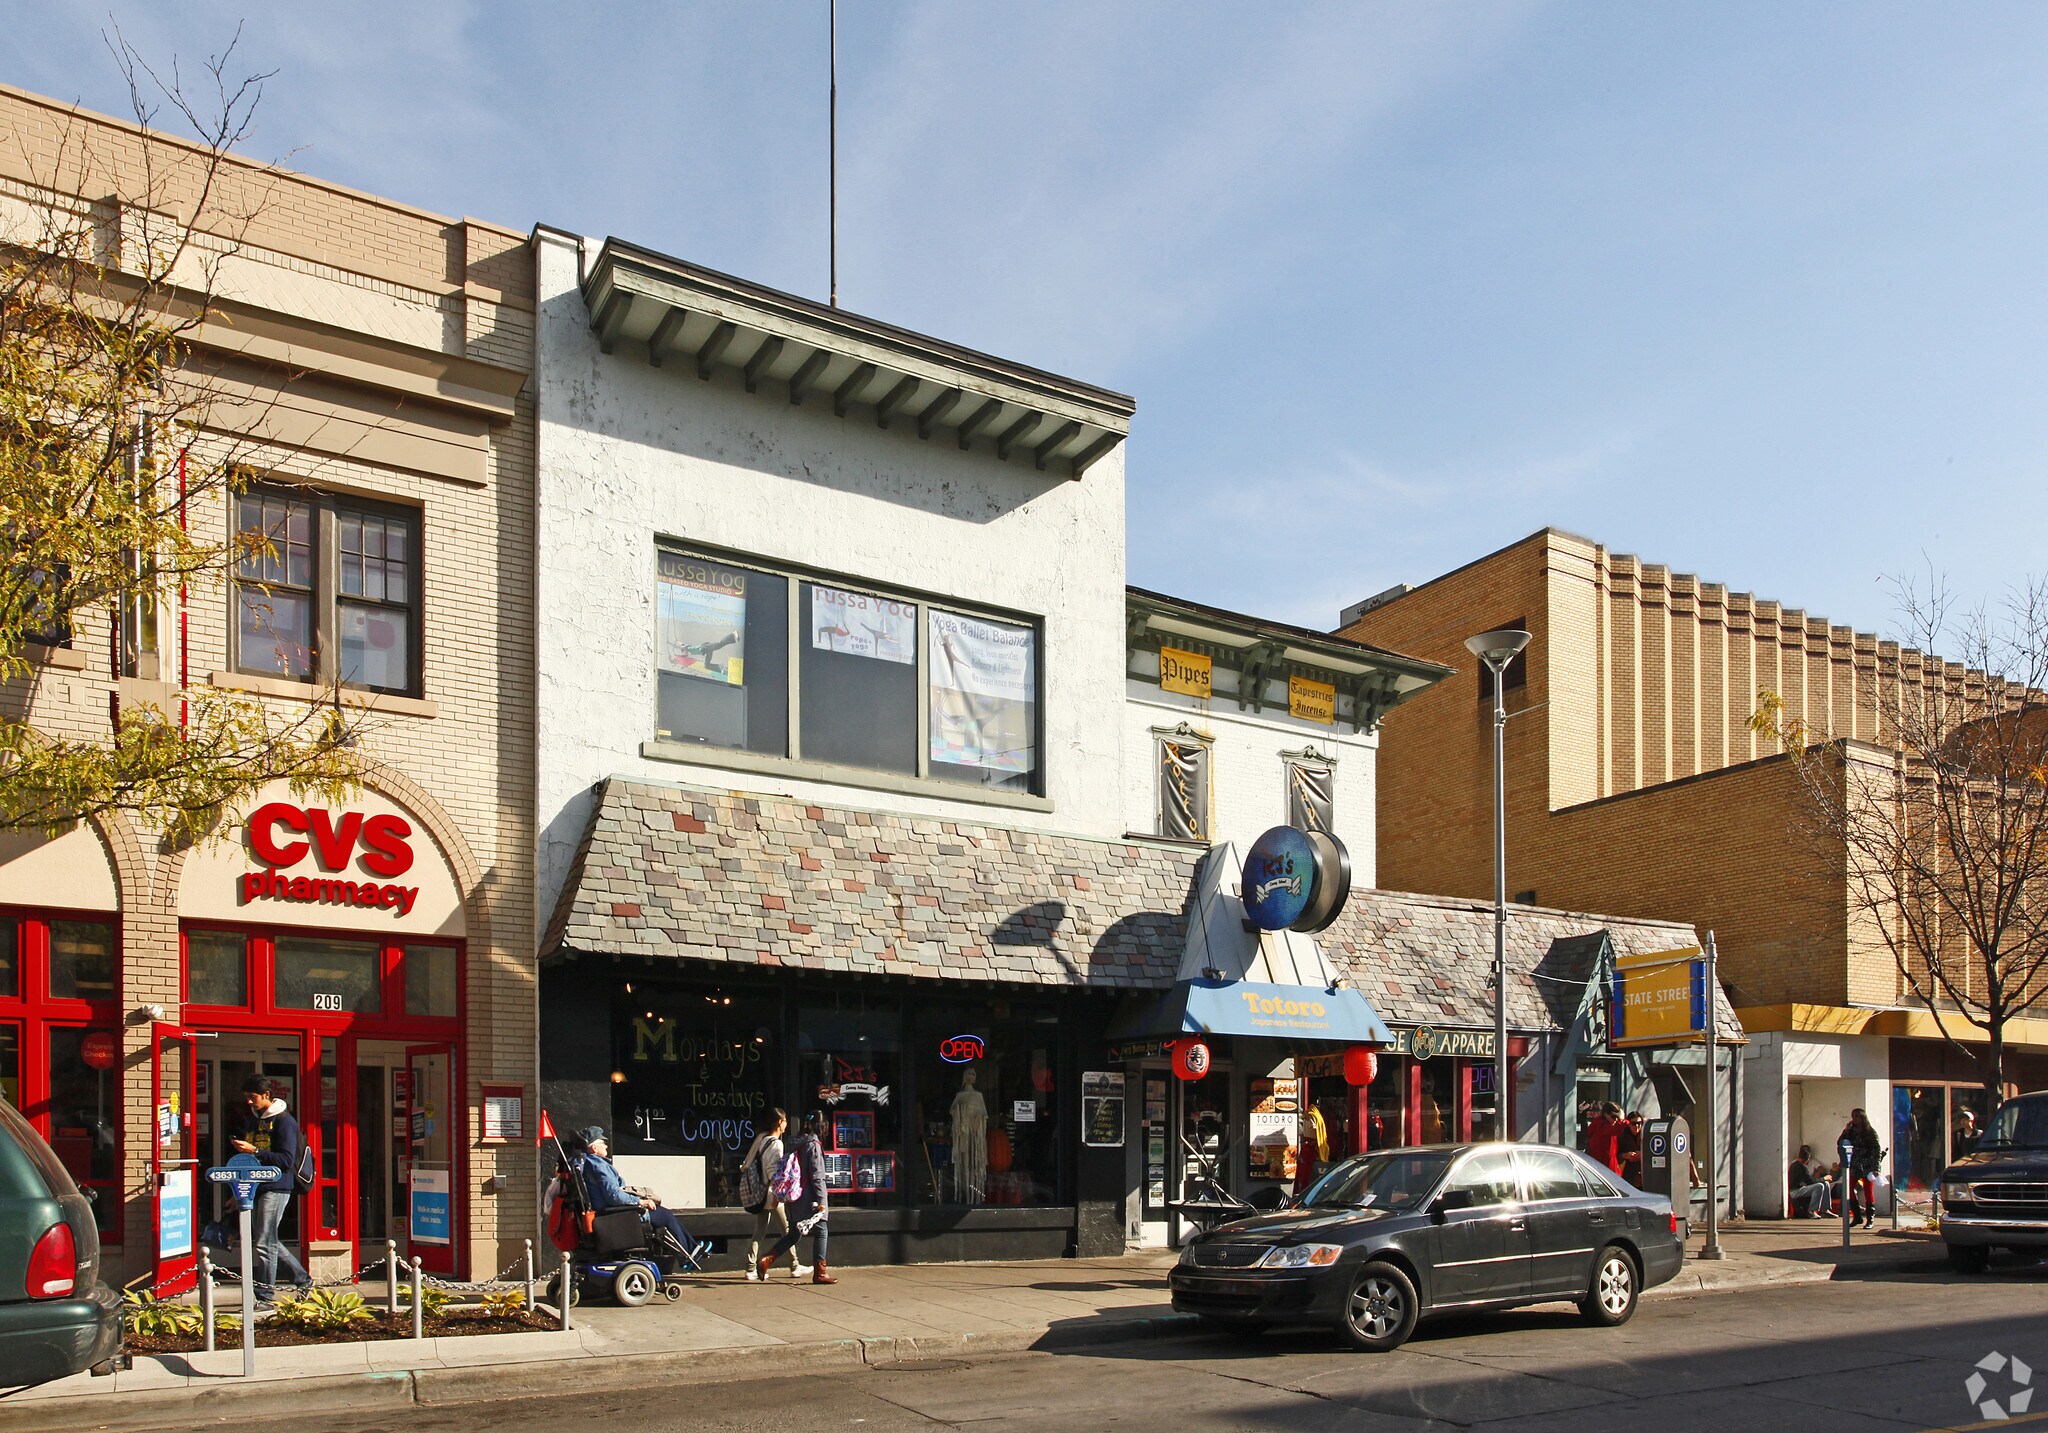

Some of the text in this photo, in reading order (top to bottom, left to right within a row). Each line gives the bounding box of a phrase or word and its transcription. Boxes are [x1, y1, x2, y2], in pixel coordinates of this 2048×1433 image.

[708, 585, 732, 596] STUDIO
[932, 613, 1031, 648] Yoga Ballet Balance
[1161, 656, 1210, 685] Pipes
[1291, 681, 1333, 703] Tapestries
[1295, 699, 1328, 718] Incense
[251, 802, 414, 876] CVS
[243, 866, 420, 915] pharmacy
[315, 994, 341, 1010] 209
[1242, 992, 1326, 1018] Totoro
[1623, 986, 1691, 1008] STATE STREE
[1251, 1017, 1329, 1029] Japanese Restaurant
[632, 1017, 761, 1079] Mondays
[940, 1039, 984, 1060] OPEN
[1472, 1066, 1497, 1092] PEN
[686, 1082, 766, 1120] Tuesdays
[681, 1108, 756, 1151] Coneys
[1257, 1115, 1294, 1124] TOTORO
[1654, 1138, 1663, 1152] P
[1677, 1136, 1685, 1151] P
[215, 1170, 272, 1179] 3631 3633
